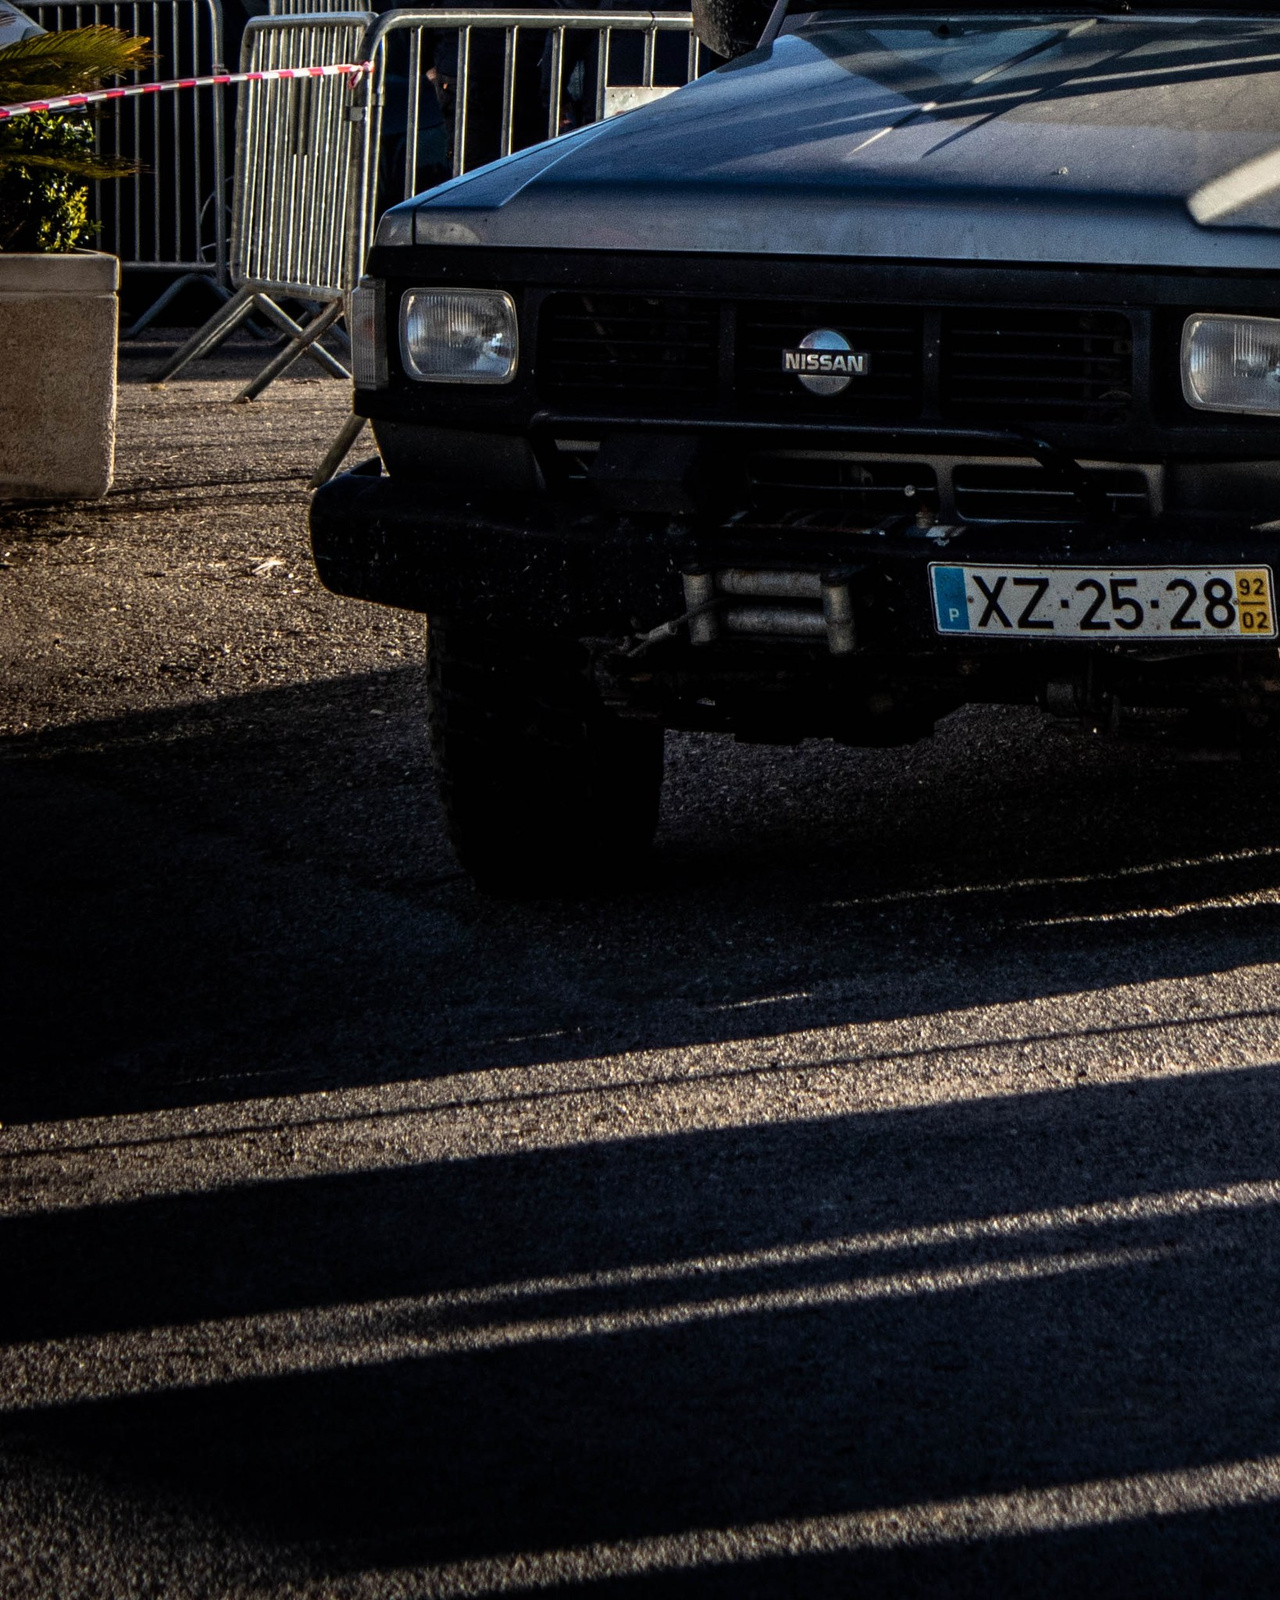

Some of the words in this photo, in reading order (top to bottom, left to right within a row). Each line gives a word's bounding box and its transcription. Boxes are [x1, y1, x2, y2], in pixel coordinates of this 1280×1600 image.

[785, 353, 863, 372] NISSAN
[1239, 578, 1265, 596] 92
[949, 607, 960, 622] P
[1242, 611, 1269, 629] 02
